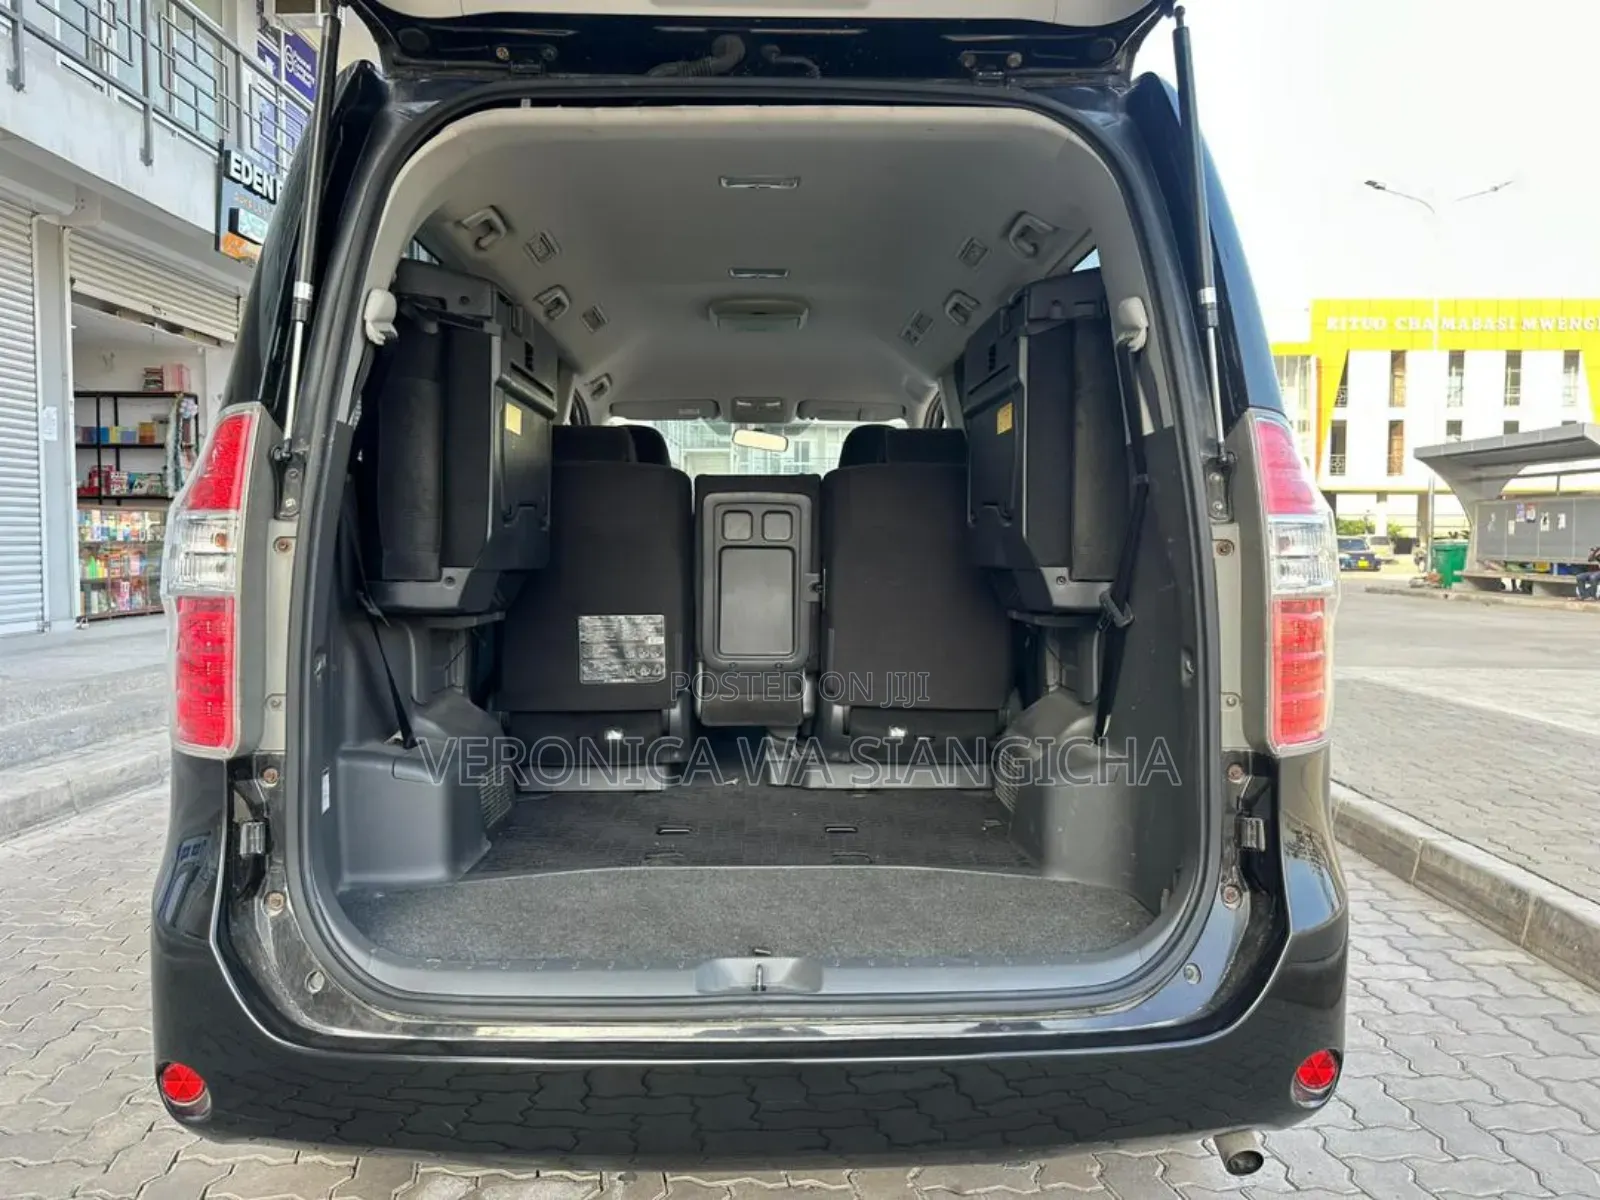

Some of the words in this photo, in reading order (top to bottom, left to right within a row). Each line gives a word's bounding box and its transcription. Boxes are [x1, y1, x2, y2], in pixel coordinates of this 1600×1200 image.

[229, 152, 275, 201] EDEN
[1326, 316, 1387, 332] KITUO
[1440, 316, 1515, 332] MABASI
